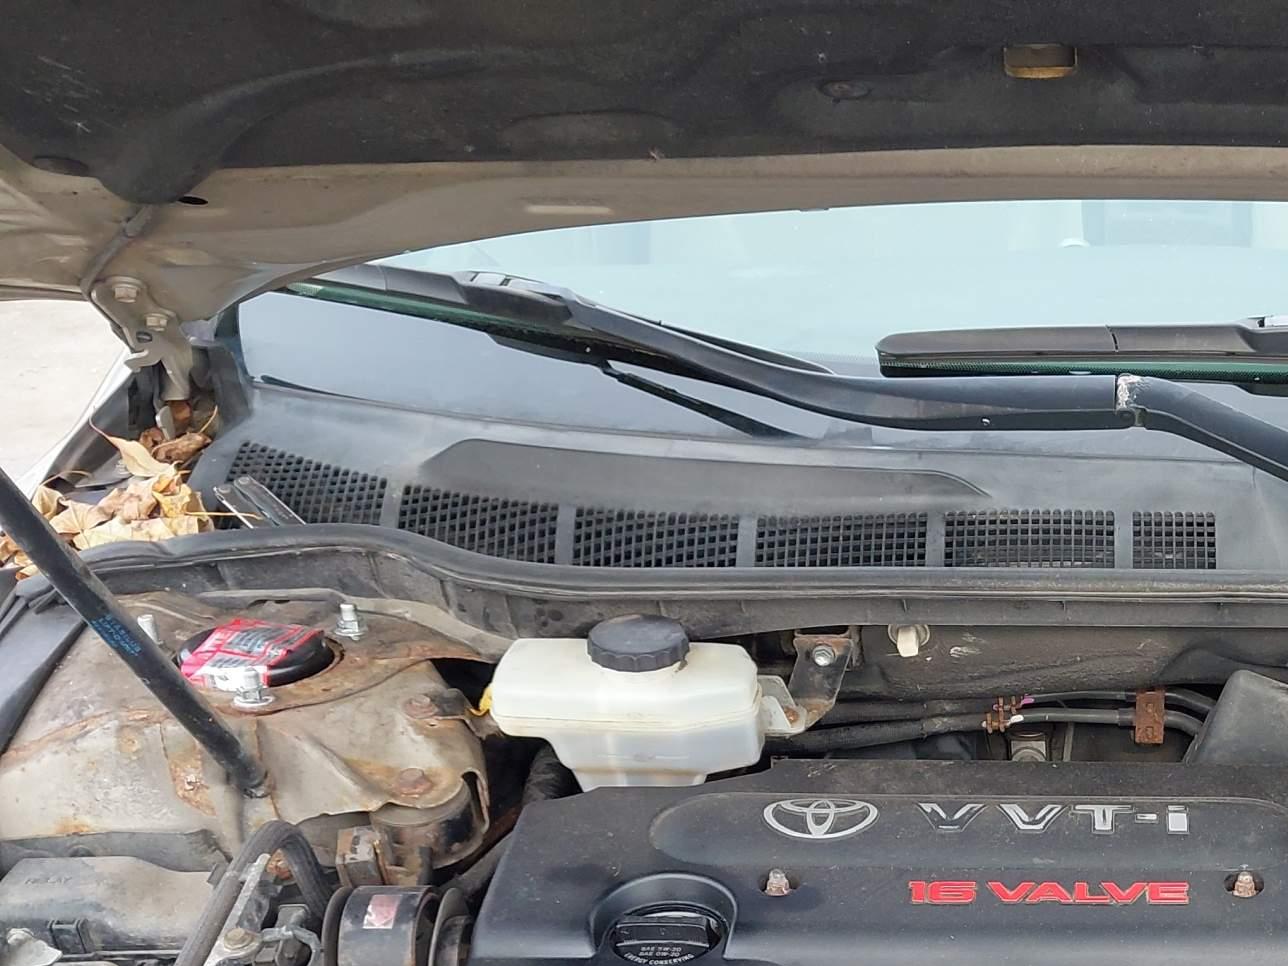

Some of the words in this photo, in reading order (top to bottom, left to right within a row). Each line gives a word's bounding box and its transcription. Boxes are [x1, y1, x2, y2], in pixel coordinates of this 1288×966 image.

[908, 879, 977, 905] 16
[987, 880, 1190, 906] VALVE
[648, 953, 695, 965] CONSERVING
